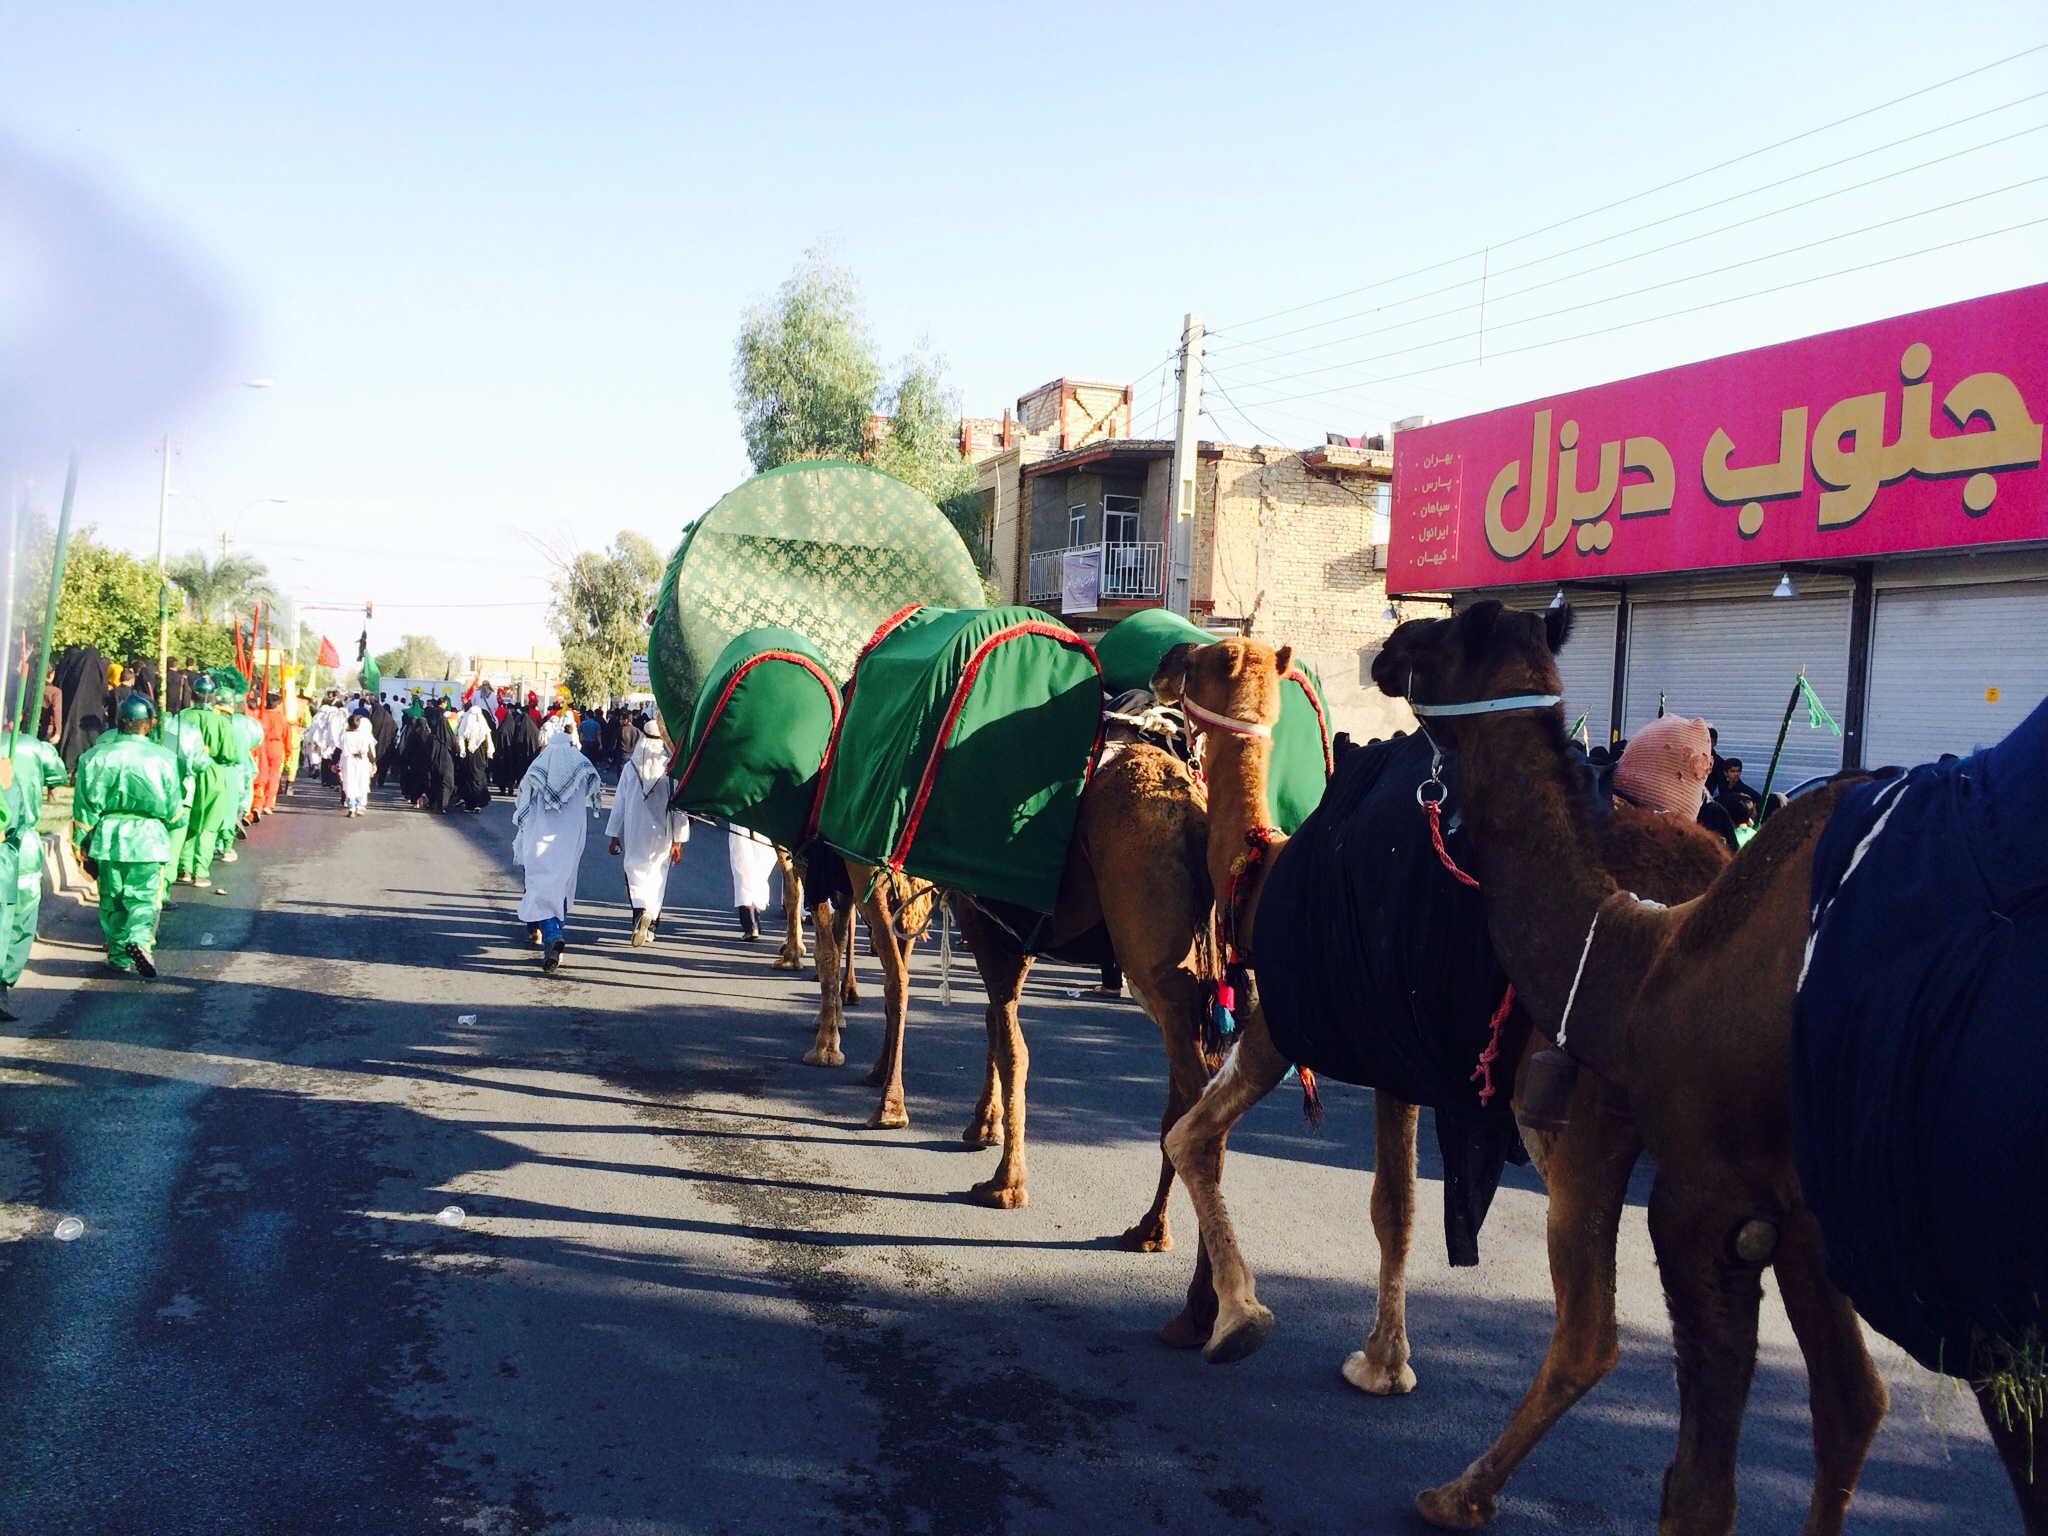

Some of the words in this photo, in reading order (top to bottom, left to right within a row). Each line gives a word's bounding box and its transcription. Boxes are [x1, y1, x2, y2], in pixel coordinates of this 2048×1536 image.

[1703, 342, 2044, 540] جنوب
[1421, 476, 1452, 493] پارس
[1484, 409, 1675, 561] دیزل
[1420, 501, 1450, 518] سپاهان
[1418, 525, 1449, 543] ایرانول
[1417, 549, 1448, 566] کیهان
